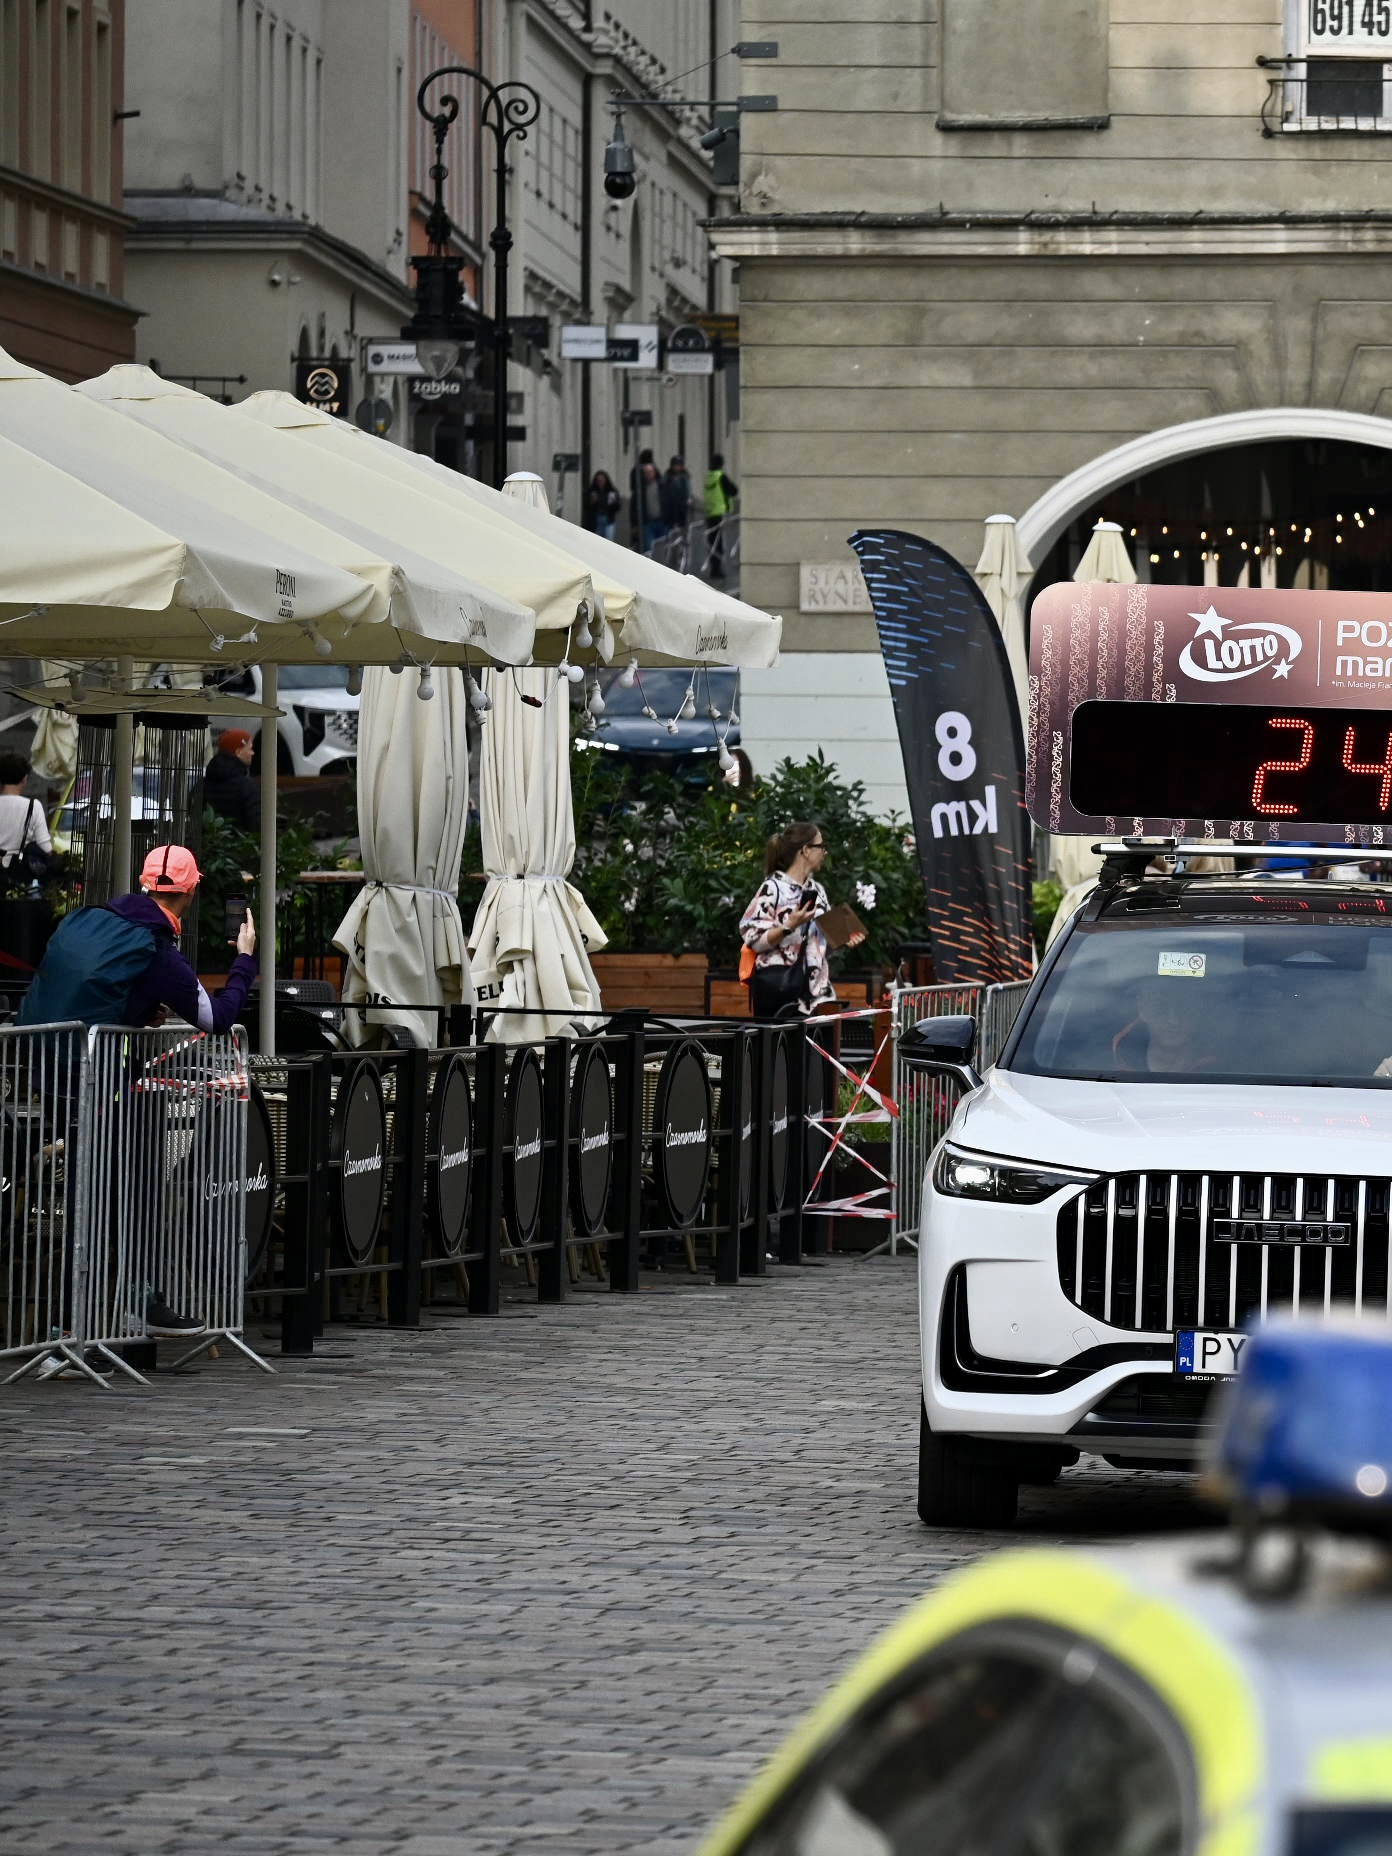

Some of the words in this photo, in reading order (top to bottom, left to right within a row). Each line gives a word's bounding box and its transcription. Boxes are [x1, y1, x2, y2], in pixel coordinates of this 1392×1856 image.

[1312, 0, 1353, 36] 691
[1361, 0, 1390, 37] 45
[413, 377, 461, 394] żabka
[809, 568, 861, 585] STAR
[808, 588, 864, 605] RYNE
[1204, 634, 1279, 669] LOTTO
[1347, 680, 1376, 689] Macieja
[1218, 1222, 1345, 1242] JAECOO
[1180, 1357, 1191, 1366] PL
[1202, 1337, 1247, 1370] PY
